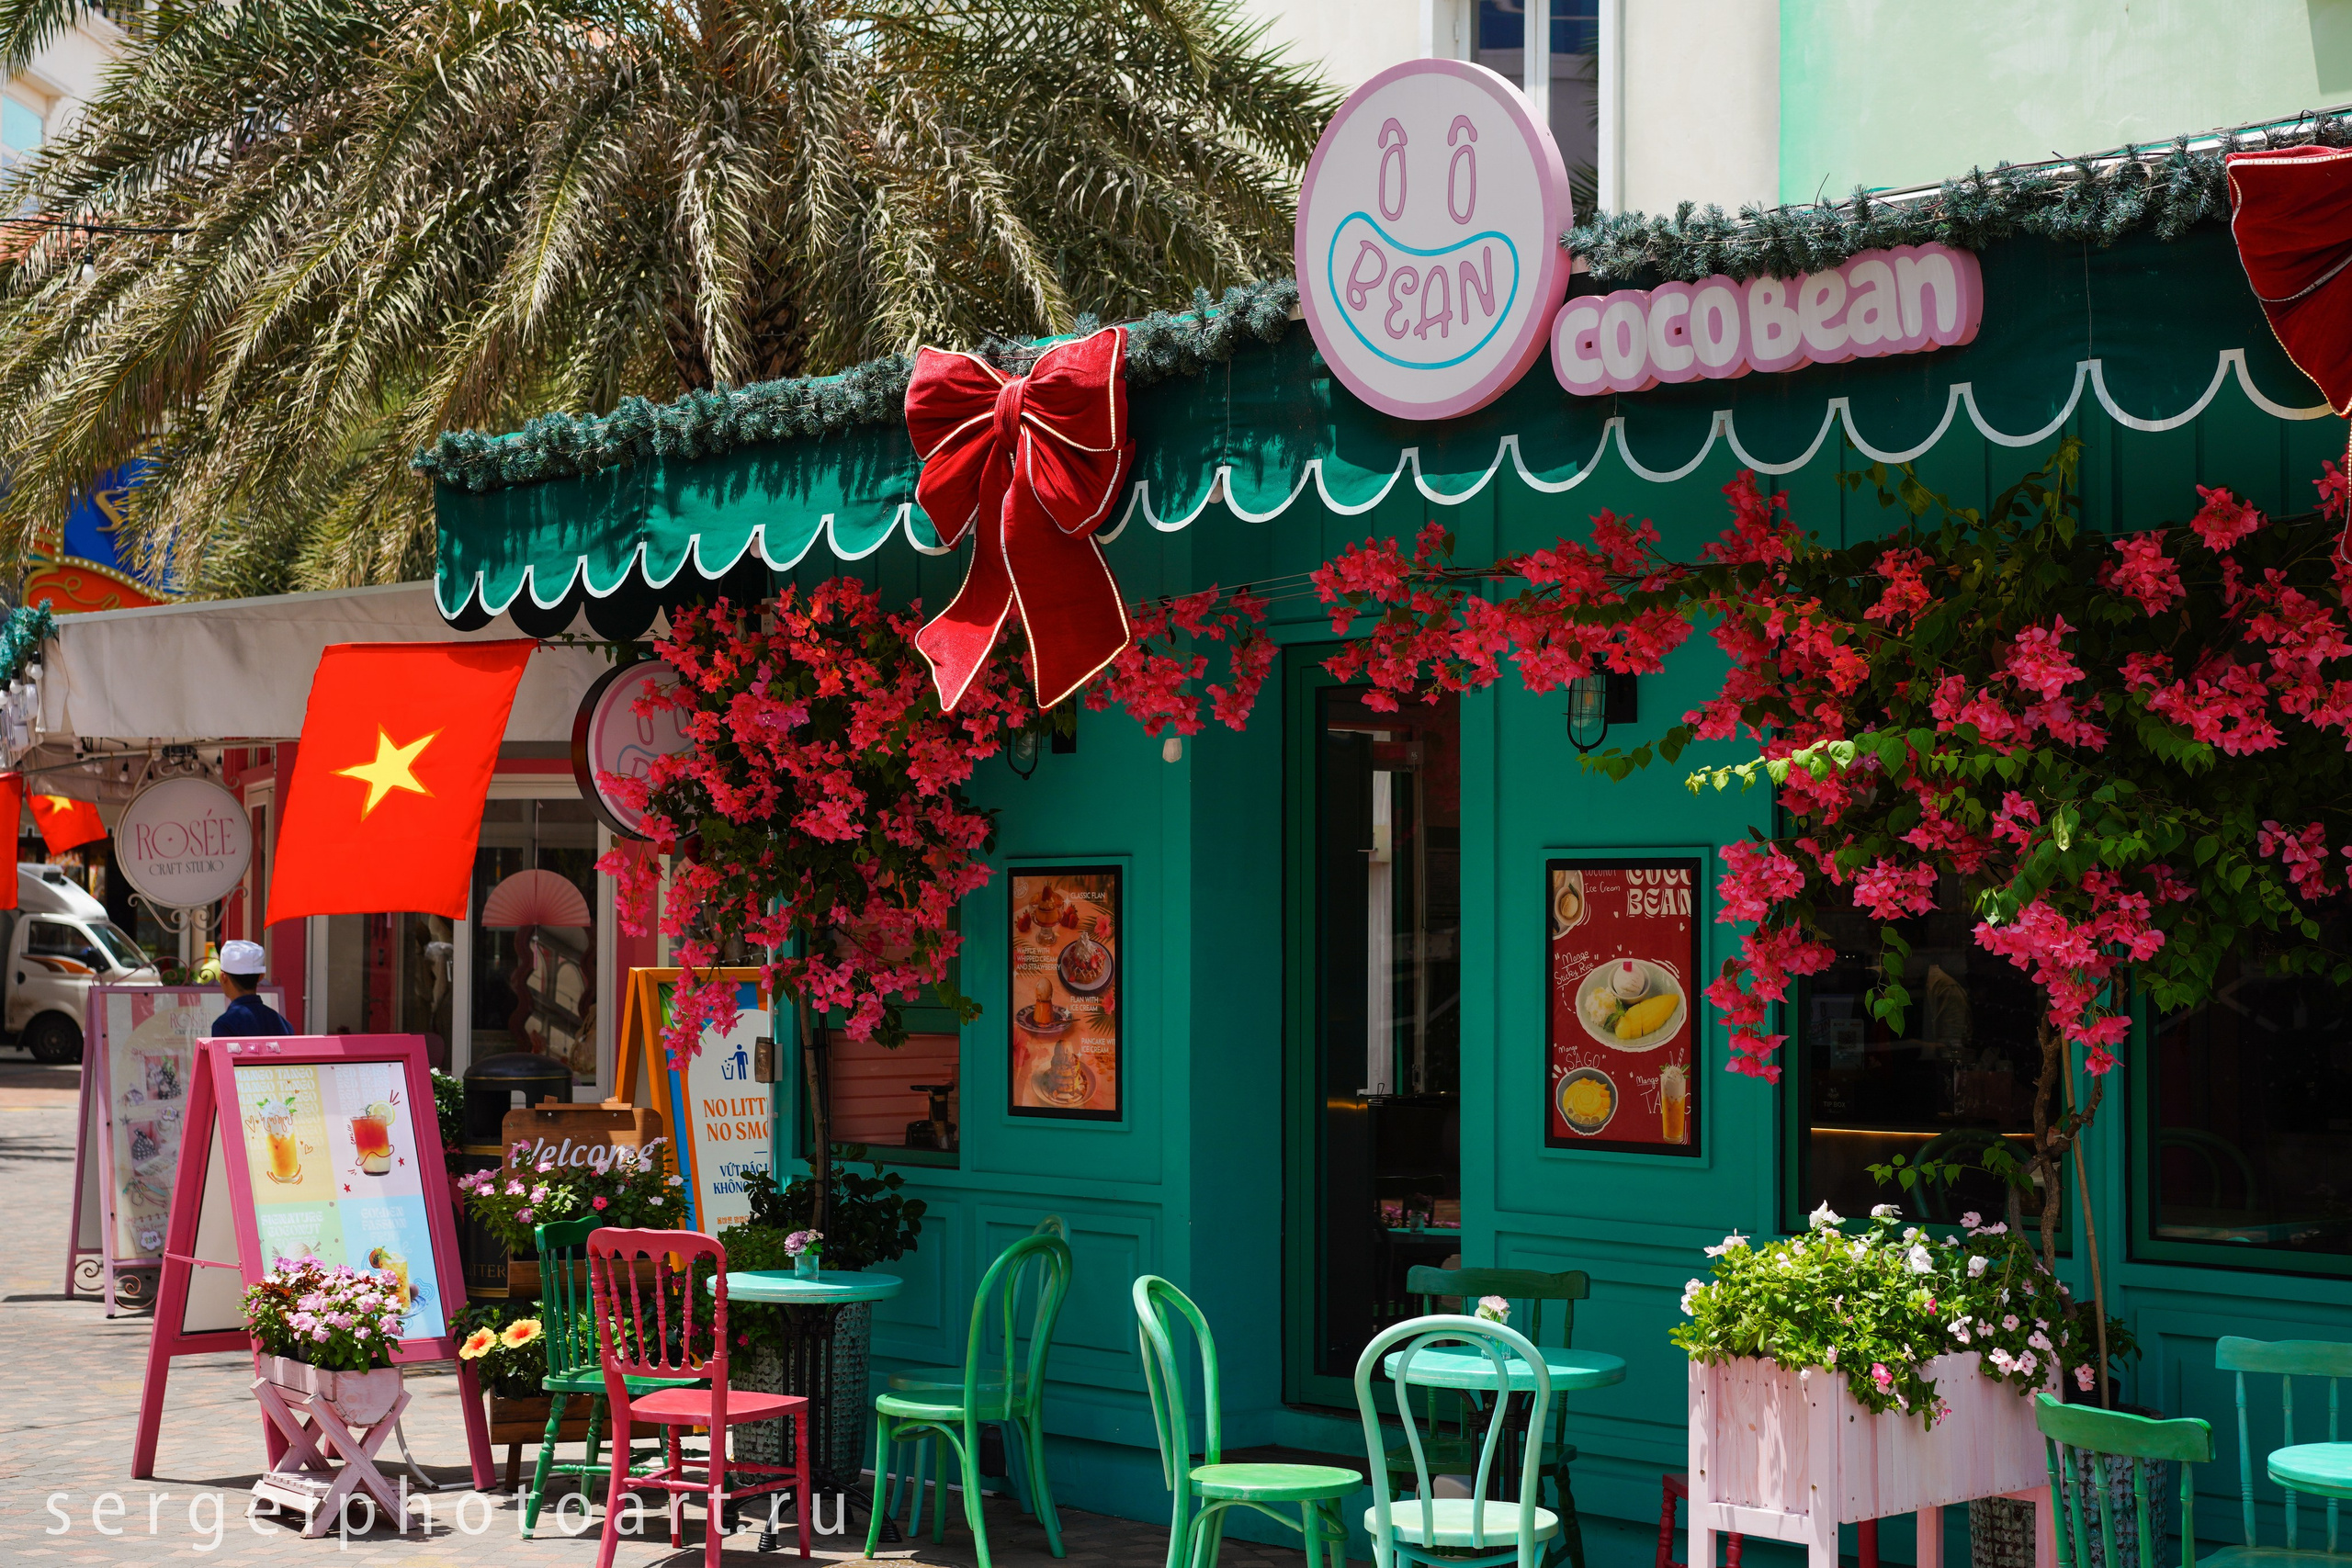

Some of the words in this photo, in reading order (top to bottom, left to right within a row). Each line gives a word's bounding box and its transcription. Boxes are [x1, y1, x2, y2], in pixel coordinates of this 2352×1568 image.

[1346, 240, 1496, 341] BEAN
[1747, 253, 1958, 361] Bean
[136, 808, 236, 861] ROSÉE
[149, 863, 183, 876] CRAFT
[186, 860, 224, 874] STUDIO
[1584, 882, 1597, 893] Ice
[1600, 881, 1621, 893] Cream
[1578, 962, 1595, 974] Rice
[1091, 1045, 1109, 1054] CREAM
[703, 1098, 728, 1118] NO
[730, 1097, 768, 1117] LITT
[706, 1122, 732, 1142] NO
